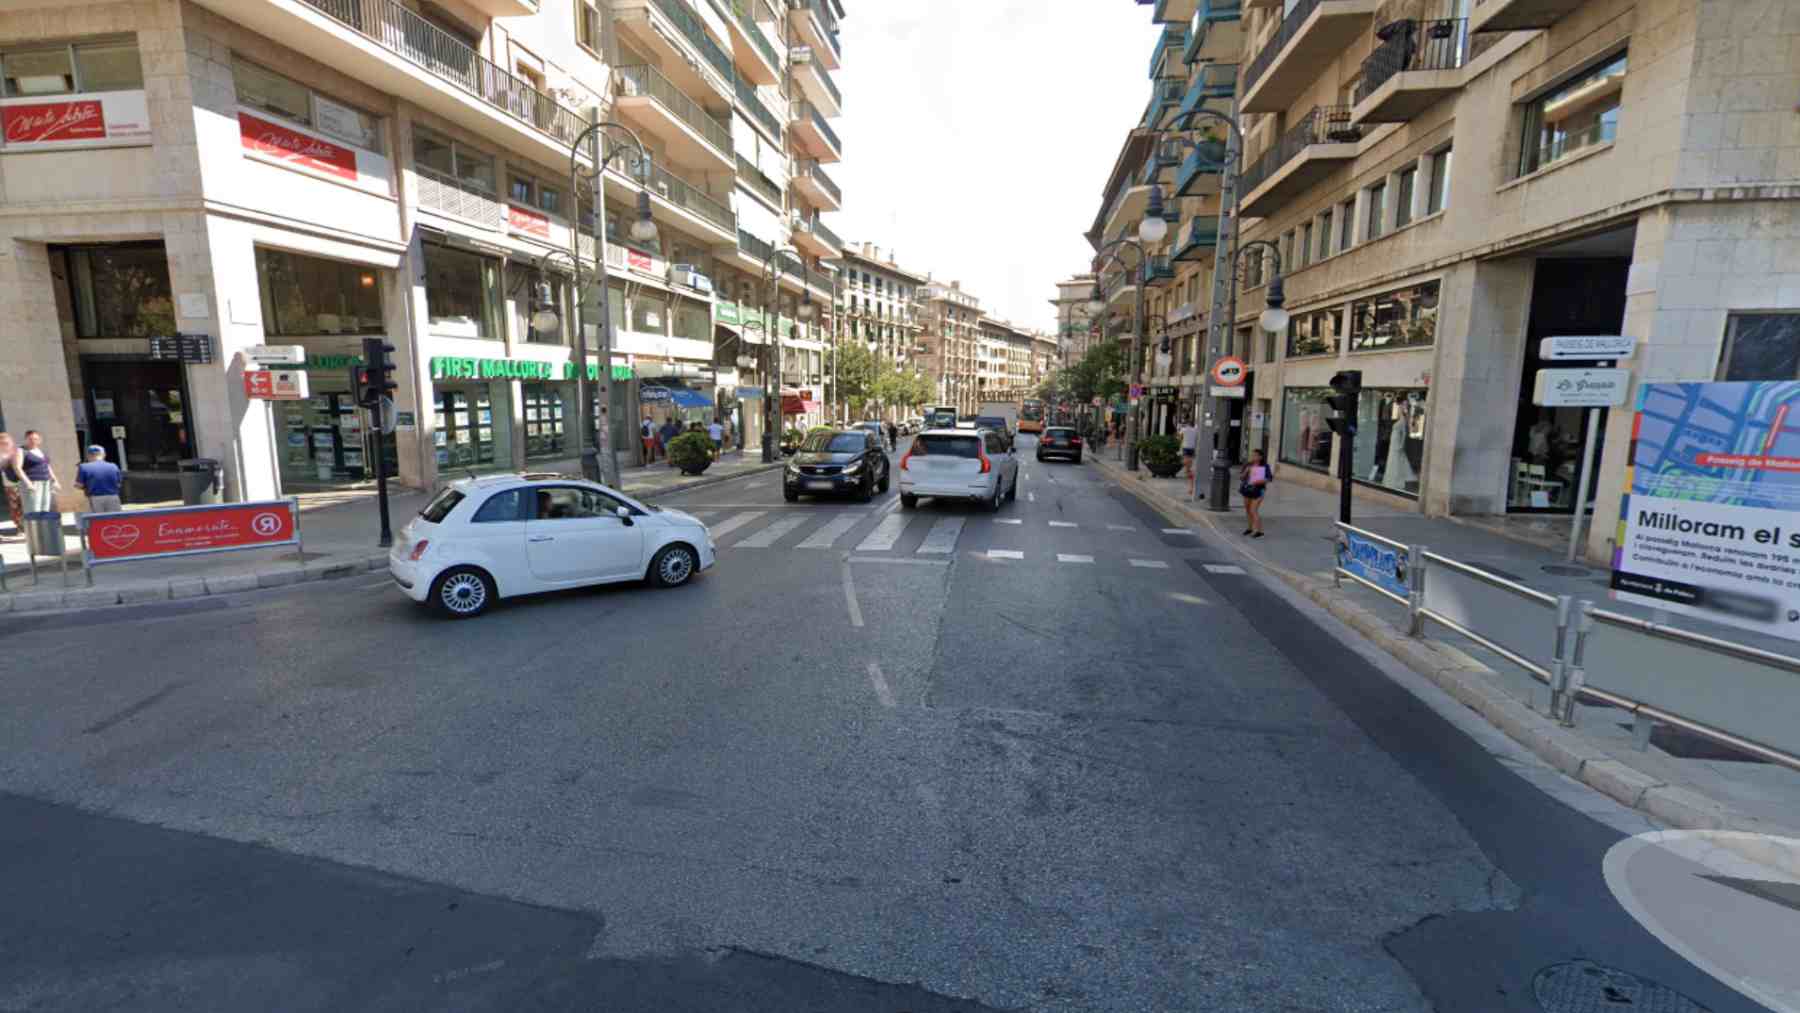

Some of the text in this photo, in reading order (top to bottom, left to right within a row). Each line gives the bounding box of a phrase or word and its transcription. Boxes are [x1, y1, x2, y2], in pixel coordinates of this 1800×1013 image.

[431, 357, 479, 379] FIRST
[479, 358, 552, 380] MALLORCA
[1638, 510, 1745, 541] Milloram
[1754, 527, 1781, 545] el
[1681, 539, 1721, 553] Mallorca
